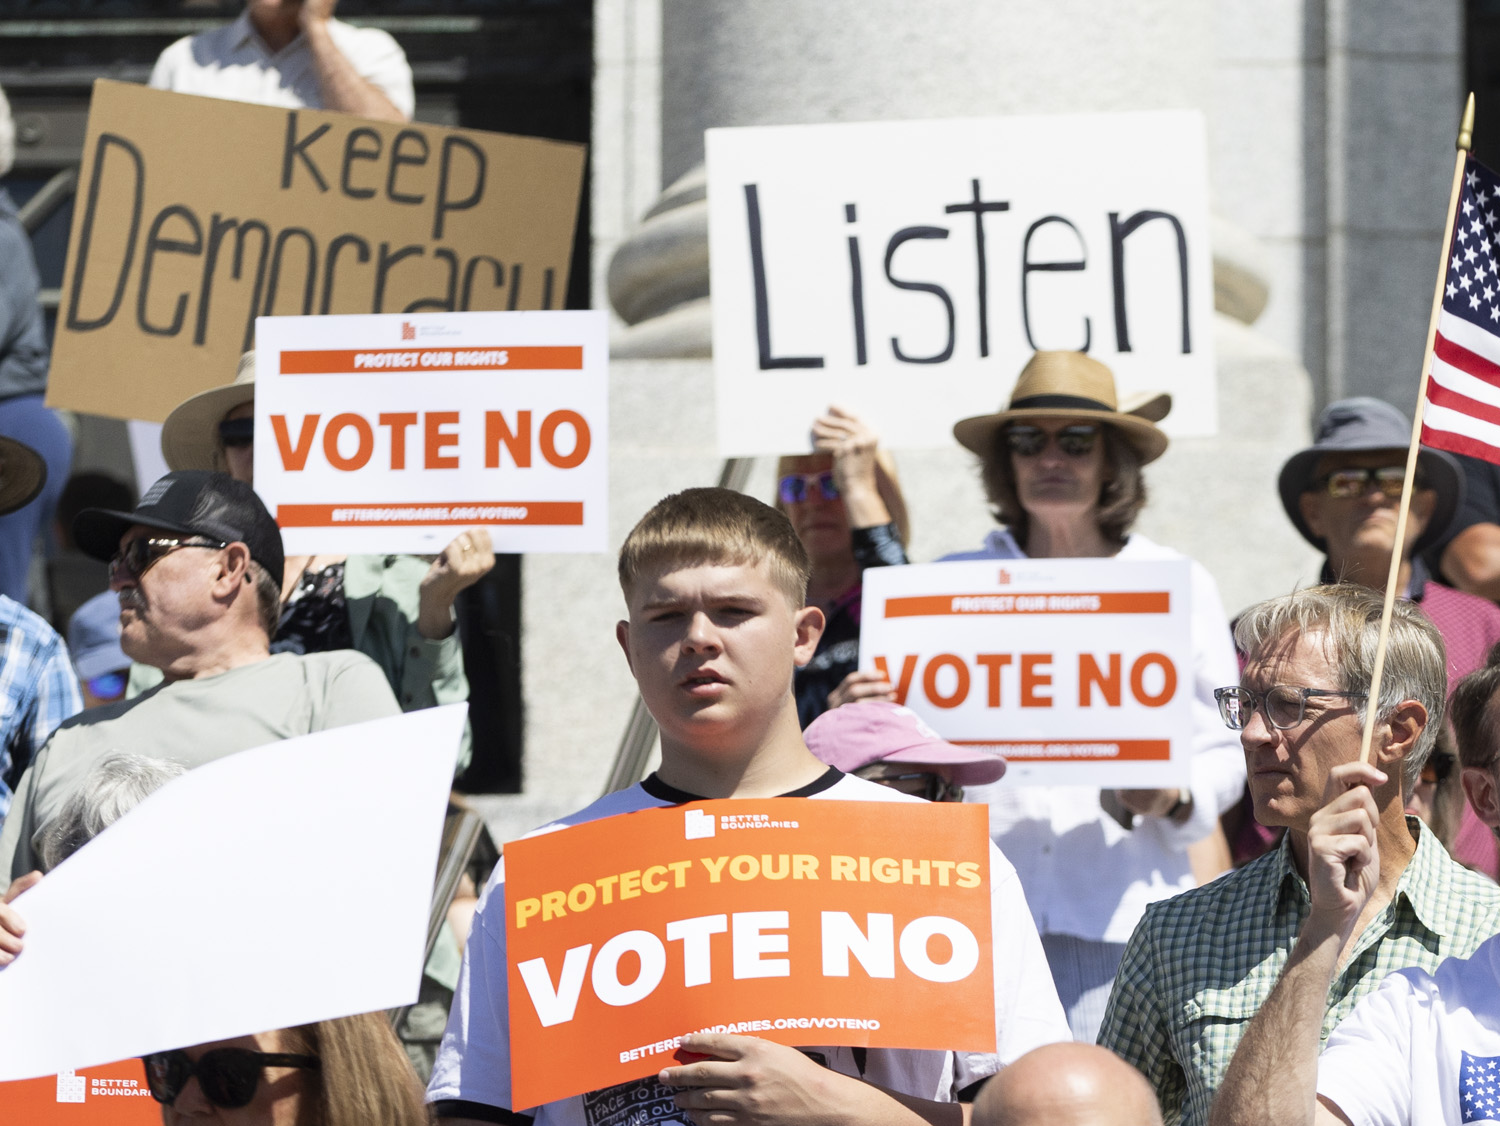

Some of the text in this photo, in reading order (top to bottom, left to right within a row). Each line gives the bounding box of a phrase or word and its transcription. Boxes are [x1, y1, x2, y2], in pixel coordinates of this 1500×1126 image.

[743, 178, 1192, 371] Listen
[354, 351, 509, 369] PROTECT OUR RIGHTS
[269, 409, 592, 472] VOTE NO
[873, 652, 1178, 709] VOTE NO
[720, 814, 769, 823] BETTER
[720, 821, 800, 830] BOUNDARIES
[515, 854, 982, 929] PROTECT YOUR RIGHTS
[517, 910, 980, 1028] VOTE NO
[91, 1078, 138, 1087] BETTER
[91, 1087, 151, 1096] BOUNDARI
[652, 1100, 680, 1115] OU
